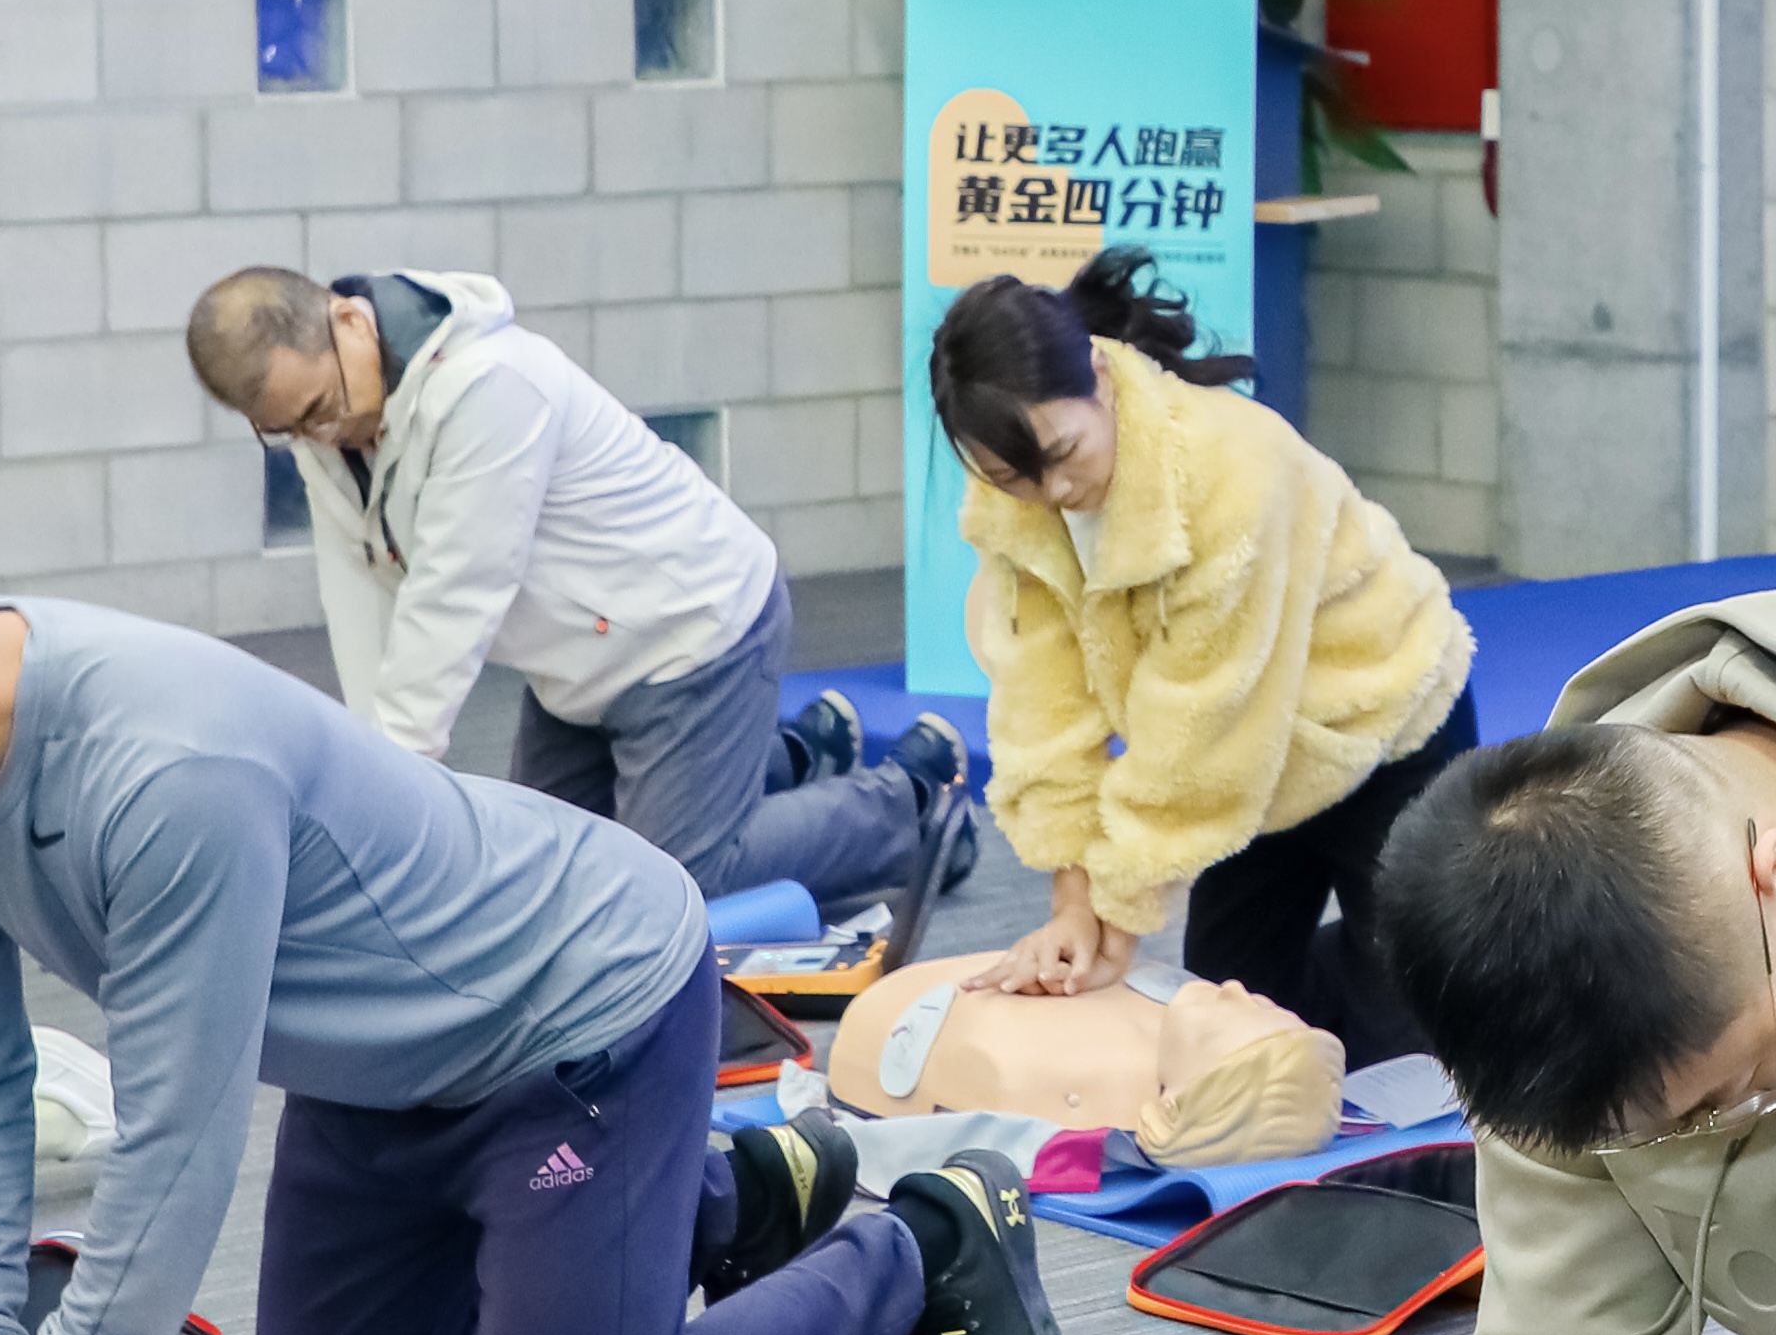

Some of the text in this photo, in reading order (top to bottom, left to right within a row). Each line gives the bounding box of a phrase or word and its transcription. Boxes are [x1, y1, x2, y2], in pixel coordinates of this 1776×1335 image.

[956, 122, 1224, 168] 让更多人跑赢
[955, 175, 1223, 229] 黄金四分钟
[529, 1167, 594, 1191] adidas
